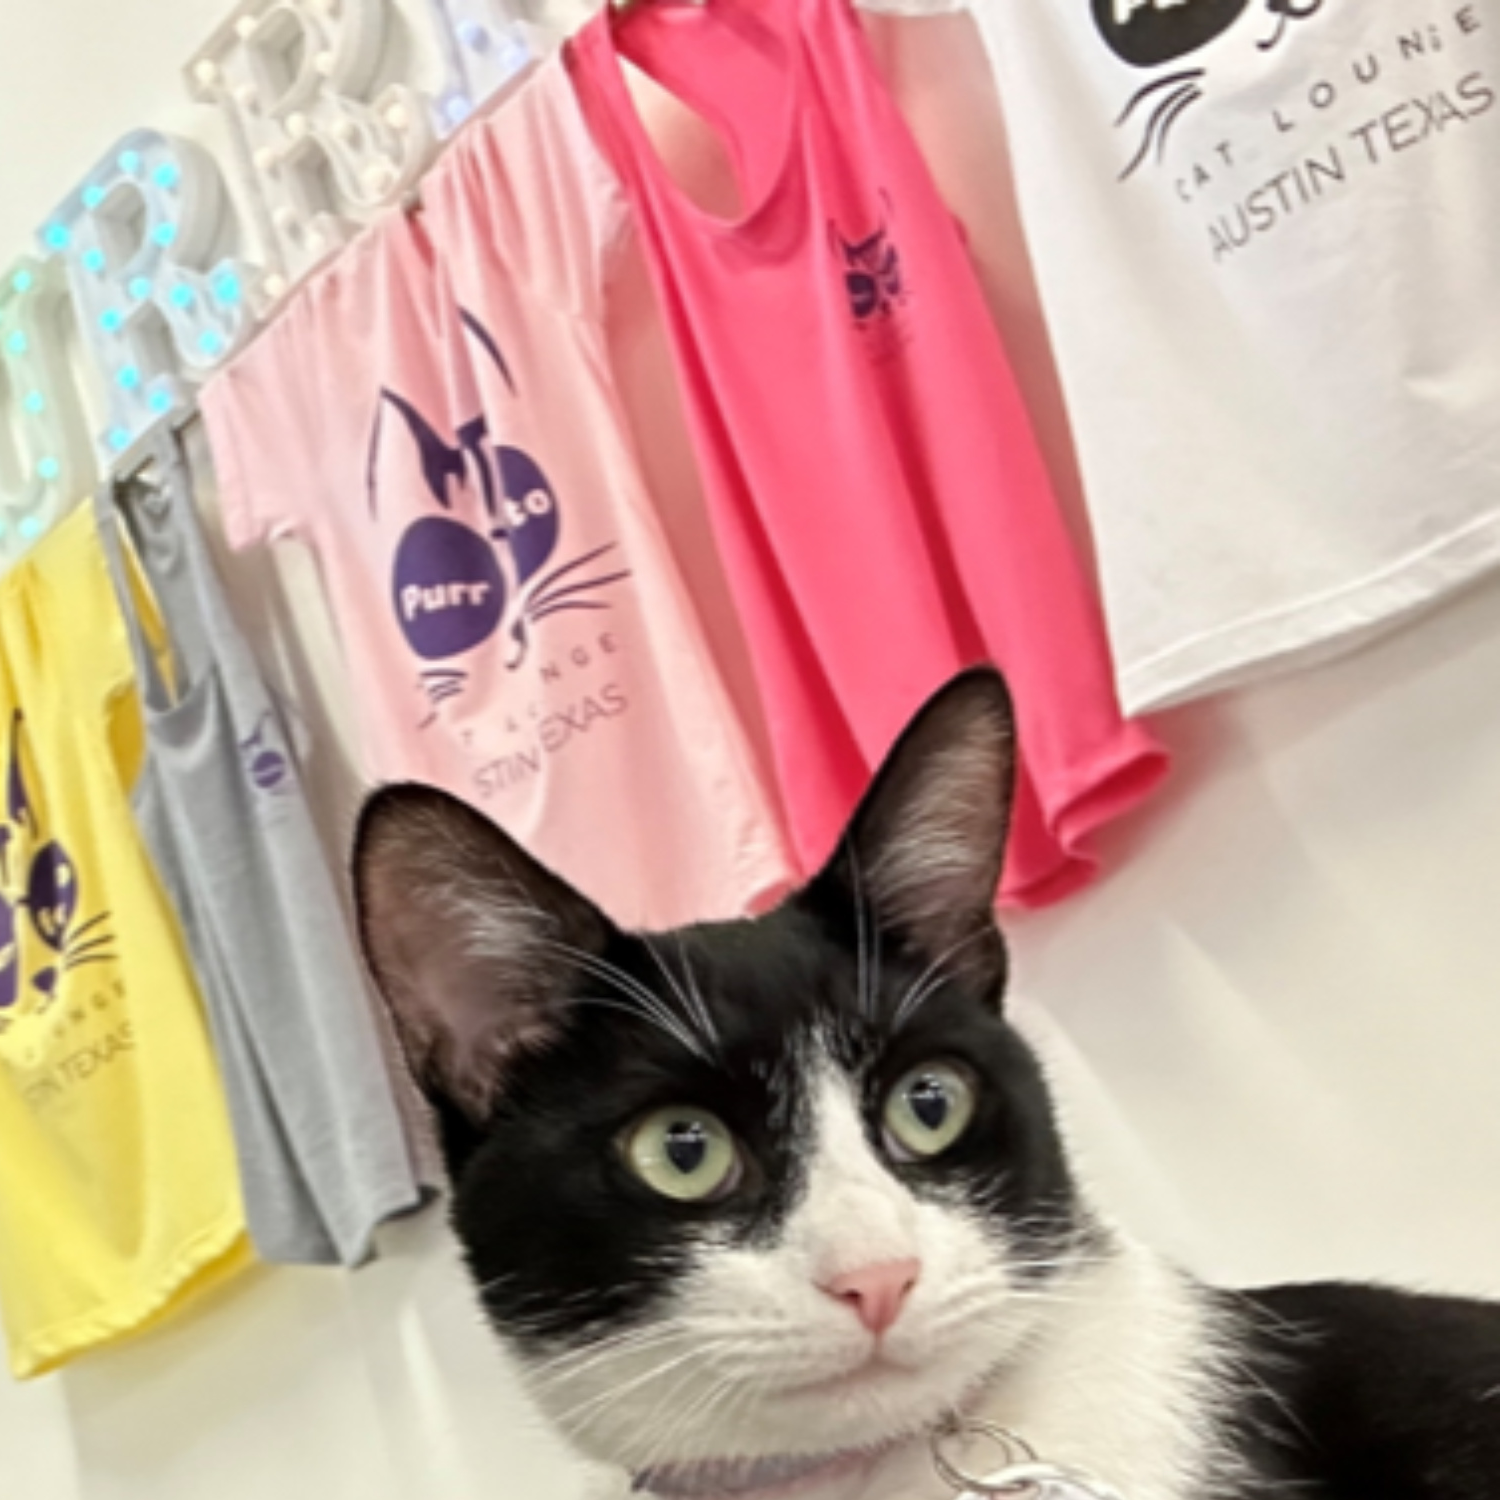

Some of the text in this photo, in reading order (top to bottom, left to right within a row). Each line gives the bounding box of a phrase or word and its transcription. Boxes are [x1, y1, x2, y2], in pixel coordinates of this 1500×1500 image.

[1174, 140, 1235, 202] CAT
[1206, 71, 1497, 262] AUSTIN TEXAS
[401, 580, 490, 621] Purr
[538, 683, 629, 753] EXAS
